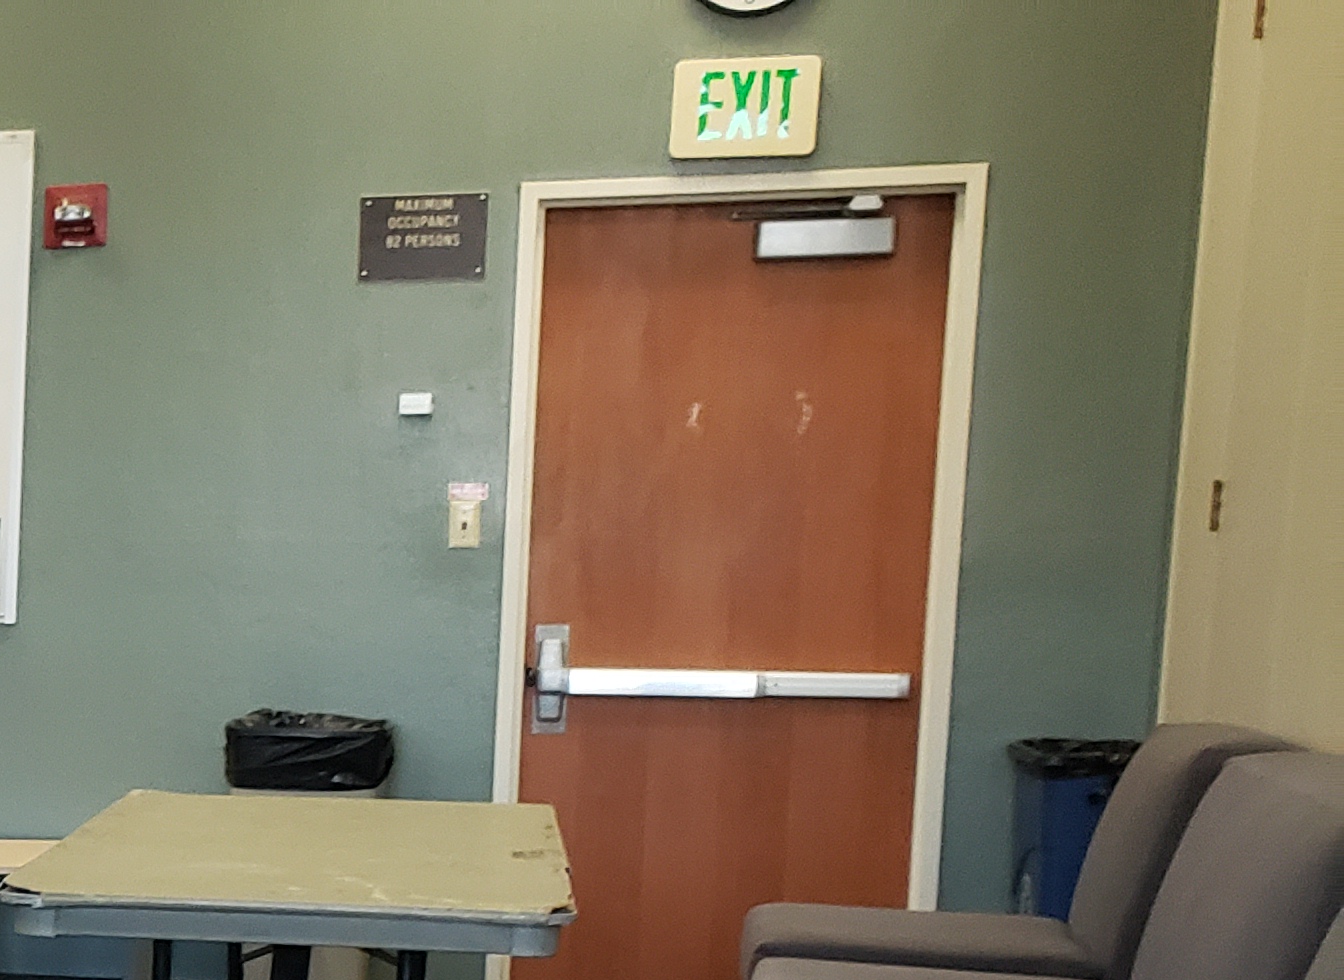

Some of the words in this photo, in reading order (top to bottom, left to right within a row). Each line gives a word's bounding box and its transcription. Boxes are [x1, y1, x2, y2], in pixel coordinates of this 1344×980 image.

[697, 67, 801, 141] EXIT
[387, 214, 460, 230] OCCUPANCY
[404, 232, 461, 248] PERSONS
